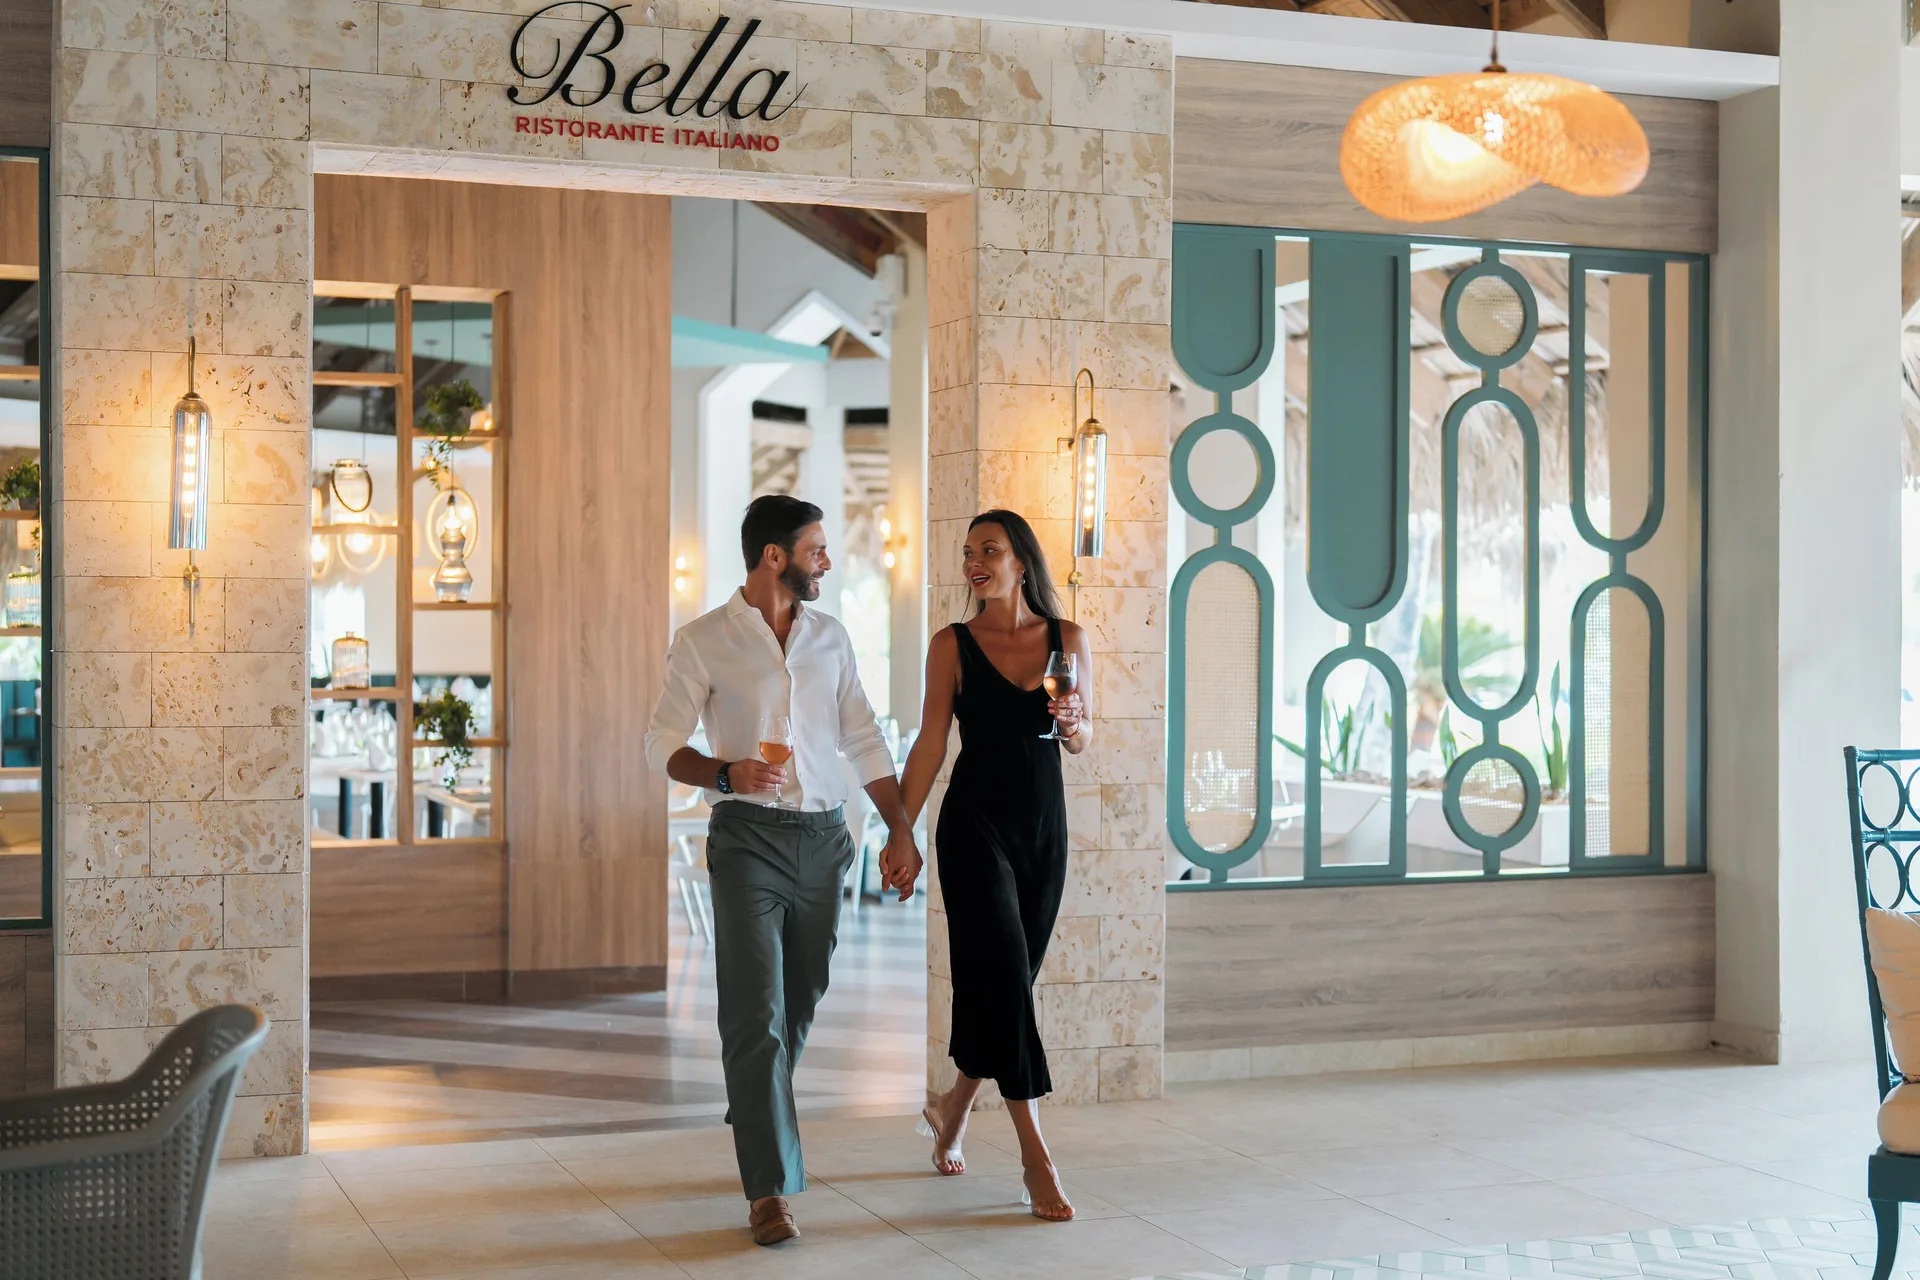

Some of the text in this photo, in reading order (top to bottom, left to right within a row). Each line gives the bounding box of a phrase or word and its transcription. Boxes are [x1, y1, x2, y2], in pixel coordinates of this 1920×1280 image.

[507, 1, 808, 120] Bella
[515, 116, 780, 152] RISTORANTE ITALIANO
